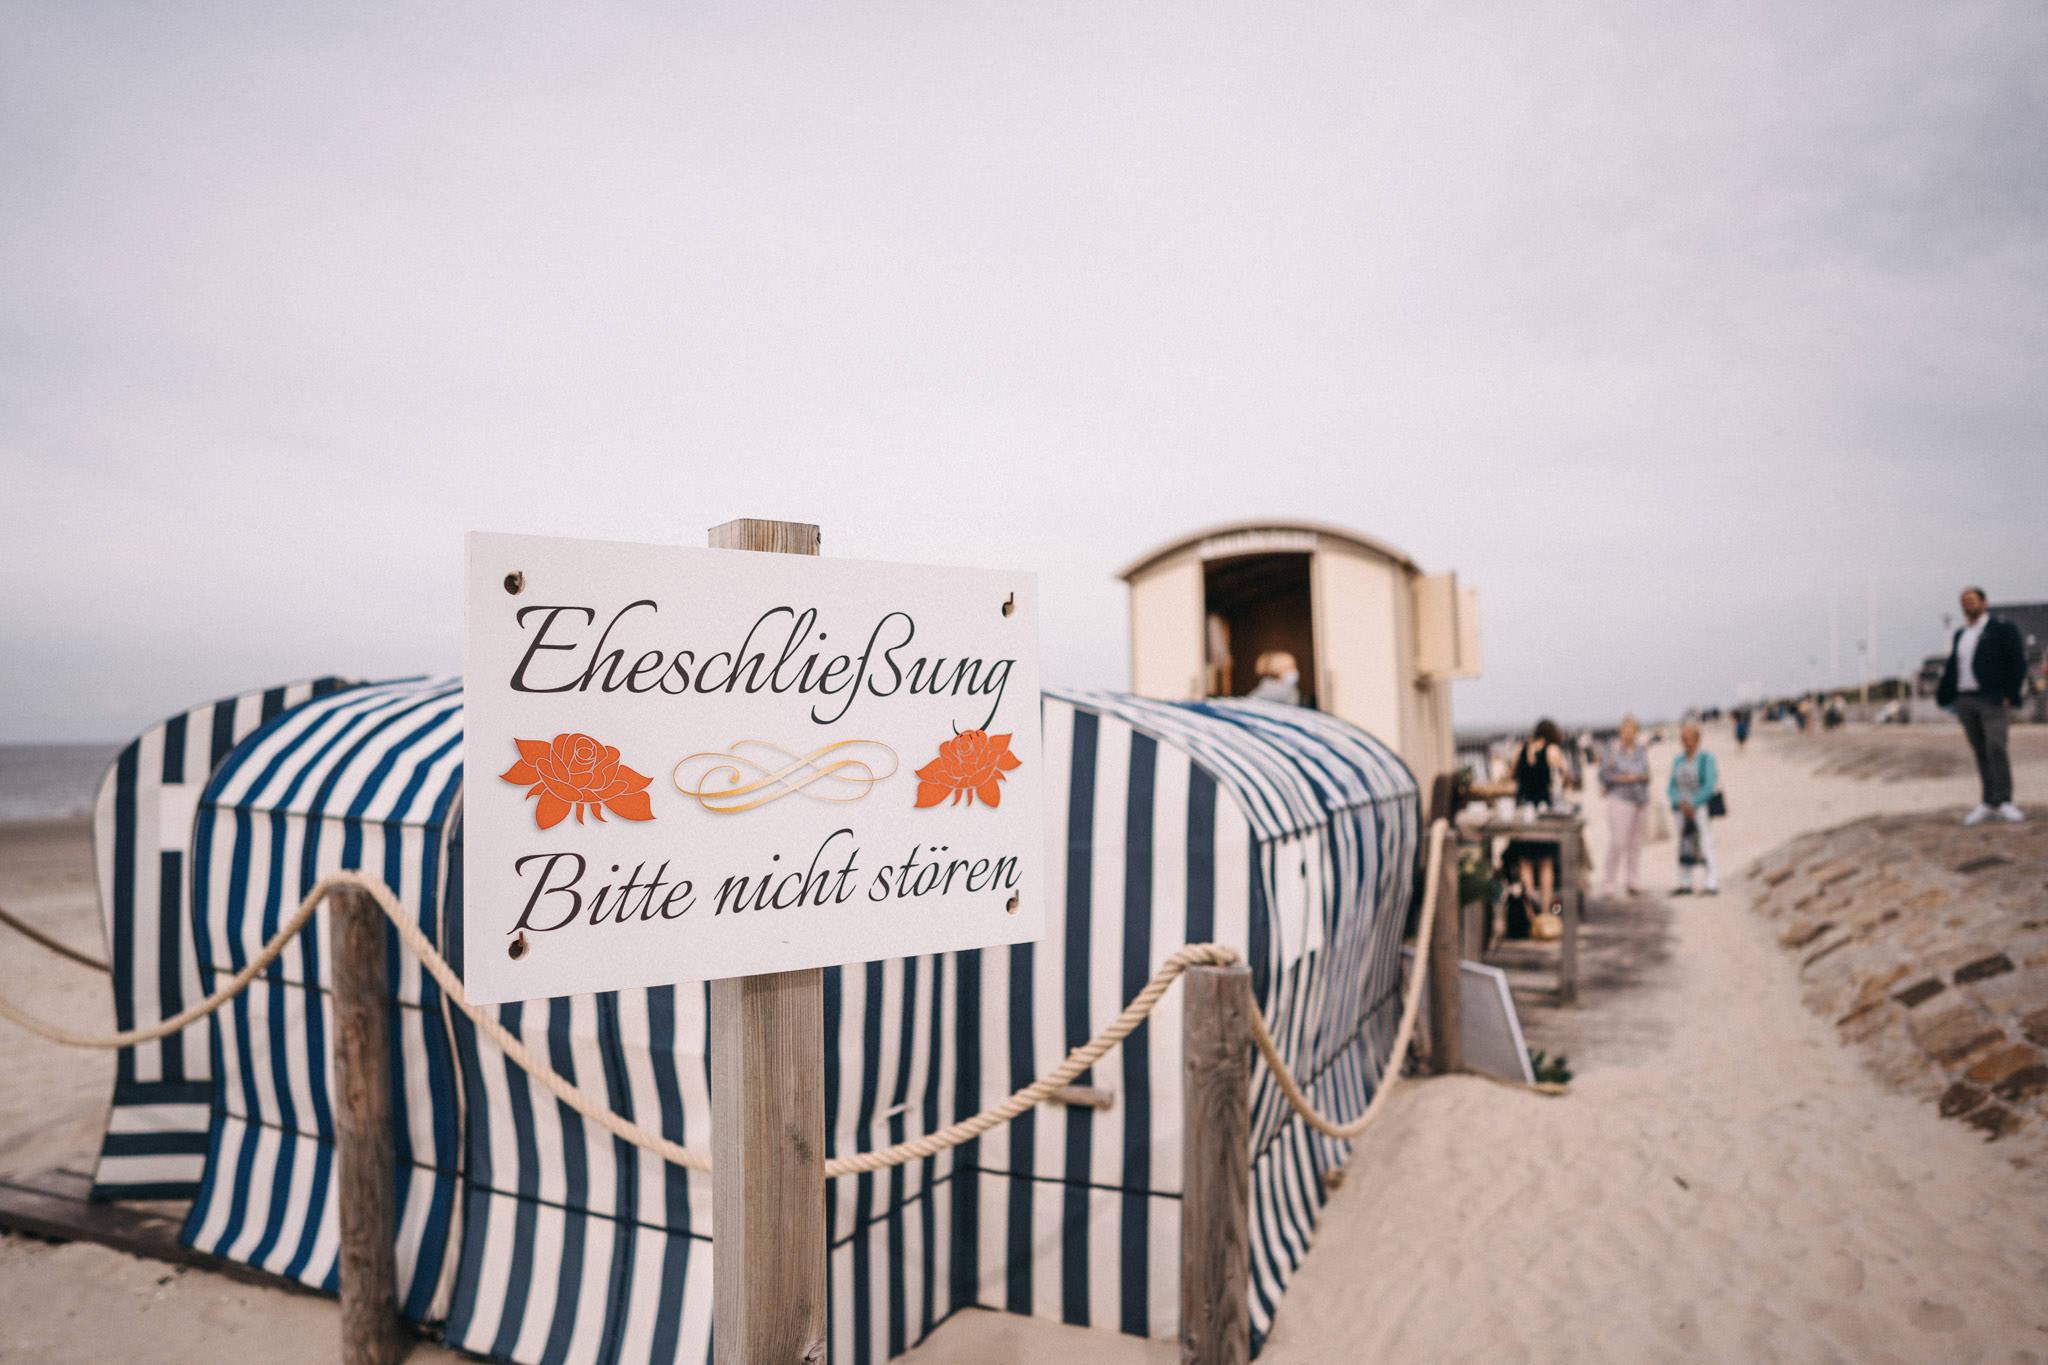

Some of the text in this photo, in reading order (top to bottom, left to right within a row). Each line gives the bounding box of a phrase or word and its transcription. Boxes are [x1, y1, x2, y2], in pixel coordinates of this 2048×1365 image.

[509, 600, 1016, 737] Eheschließung
[507, 828, 1022, 935] Bitte nicht stören
